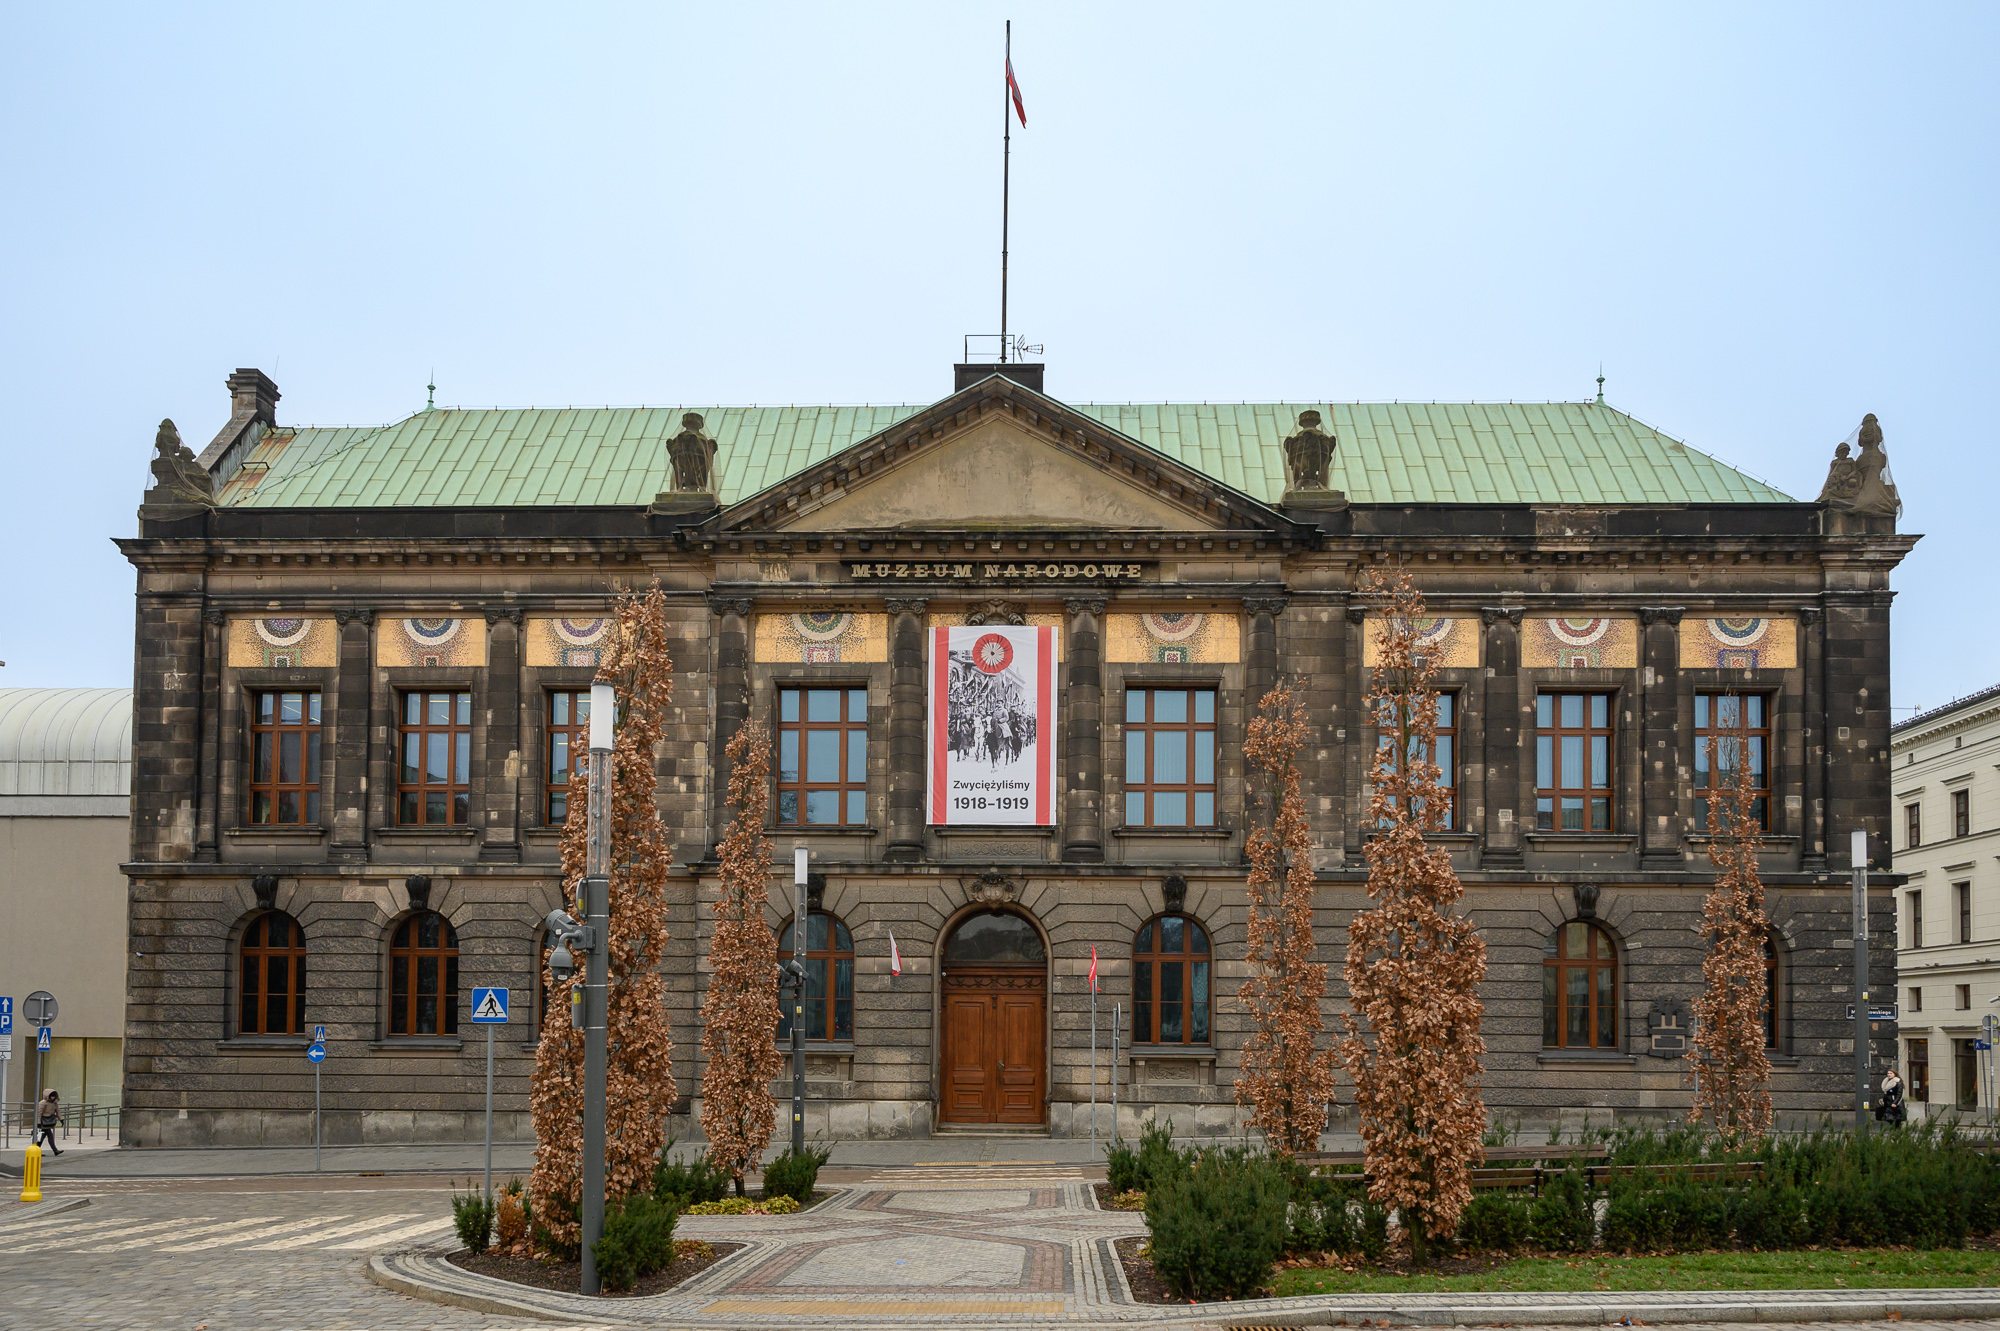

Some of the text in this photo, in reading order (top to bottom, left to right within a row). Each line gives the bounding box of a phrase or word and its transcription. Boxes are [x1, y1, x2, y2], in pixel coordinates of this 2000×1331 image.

[851, 564, 1141, 578] MUZEUM NARODOWE
[953, 780, 1030, 792] Zwyciężyliśmy
[954, 797, 1029, 810] 1918–1919
[1, 1015, 10, 1028] P
